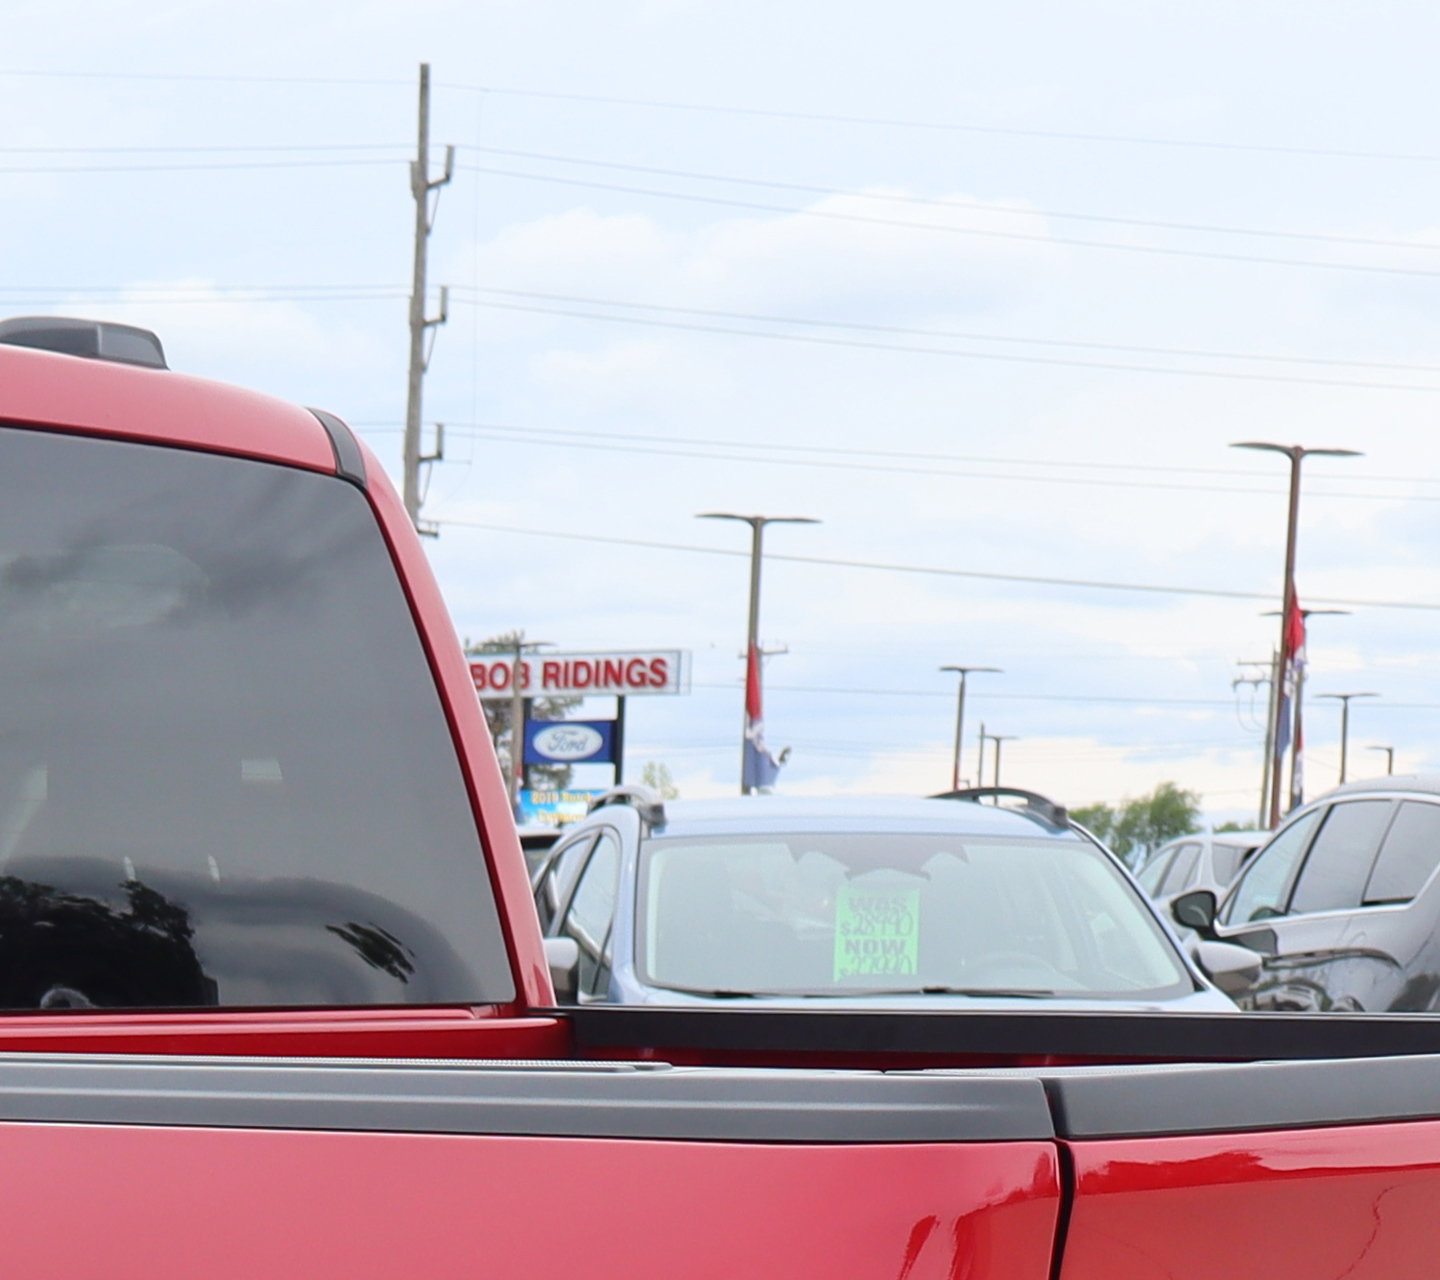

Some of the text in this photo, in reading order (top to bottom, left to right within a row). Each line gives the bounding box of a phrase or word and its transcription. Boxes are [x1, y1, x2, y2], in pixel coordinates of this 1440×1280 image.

[542, 658, 668, 689] RIDINGS
[547, 730, 588, 753] Ford
[845, 939, 905, 954] NOW
